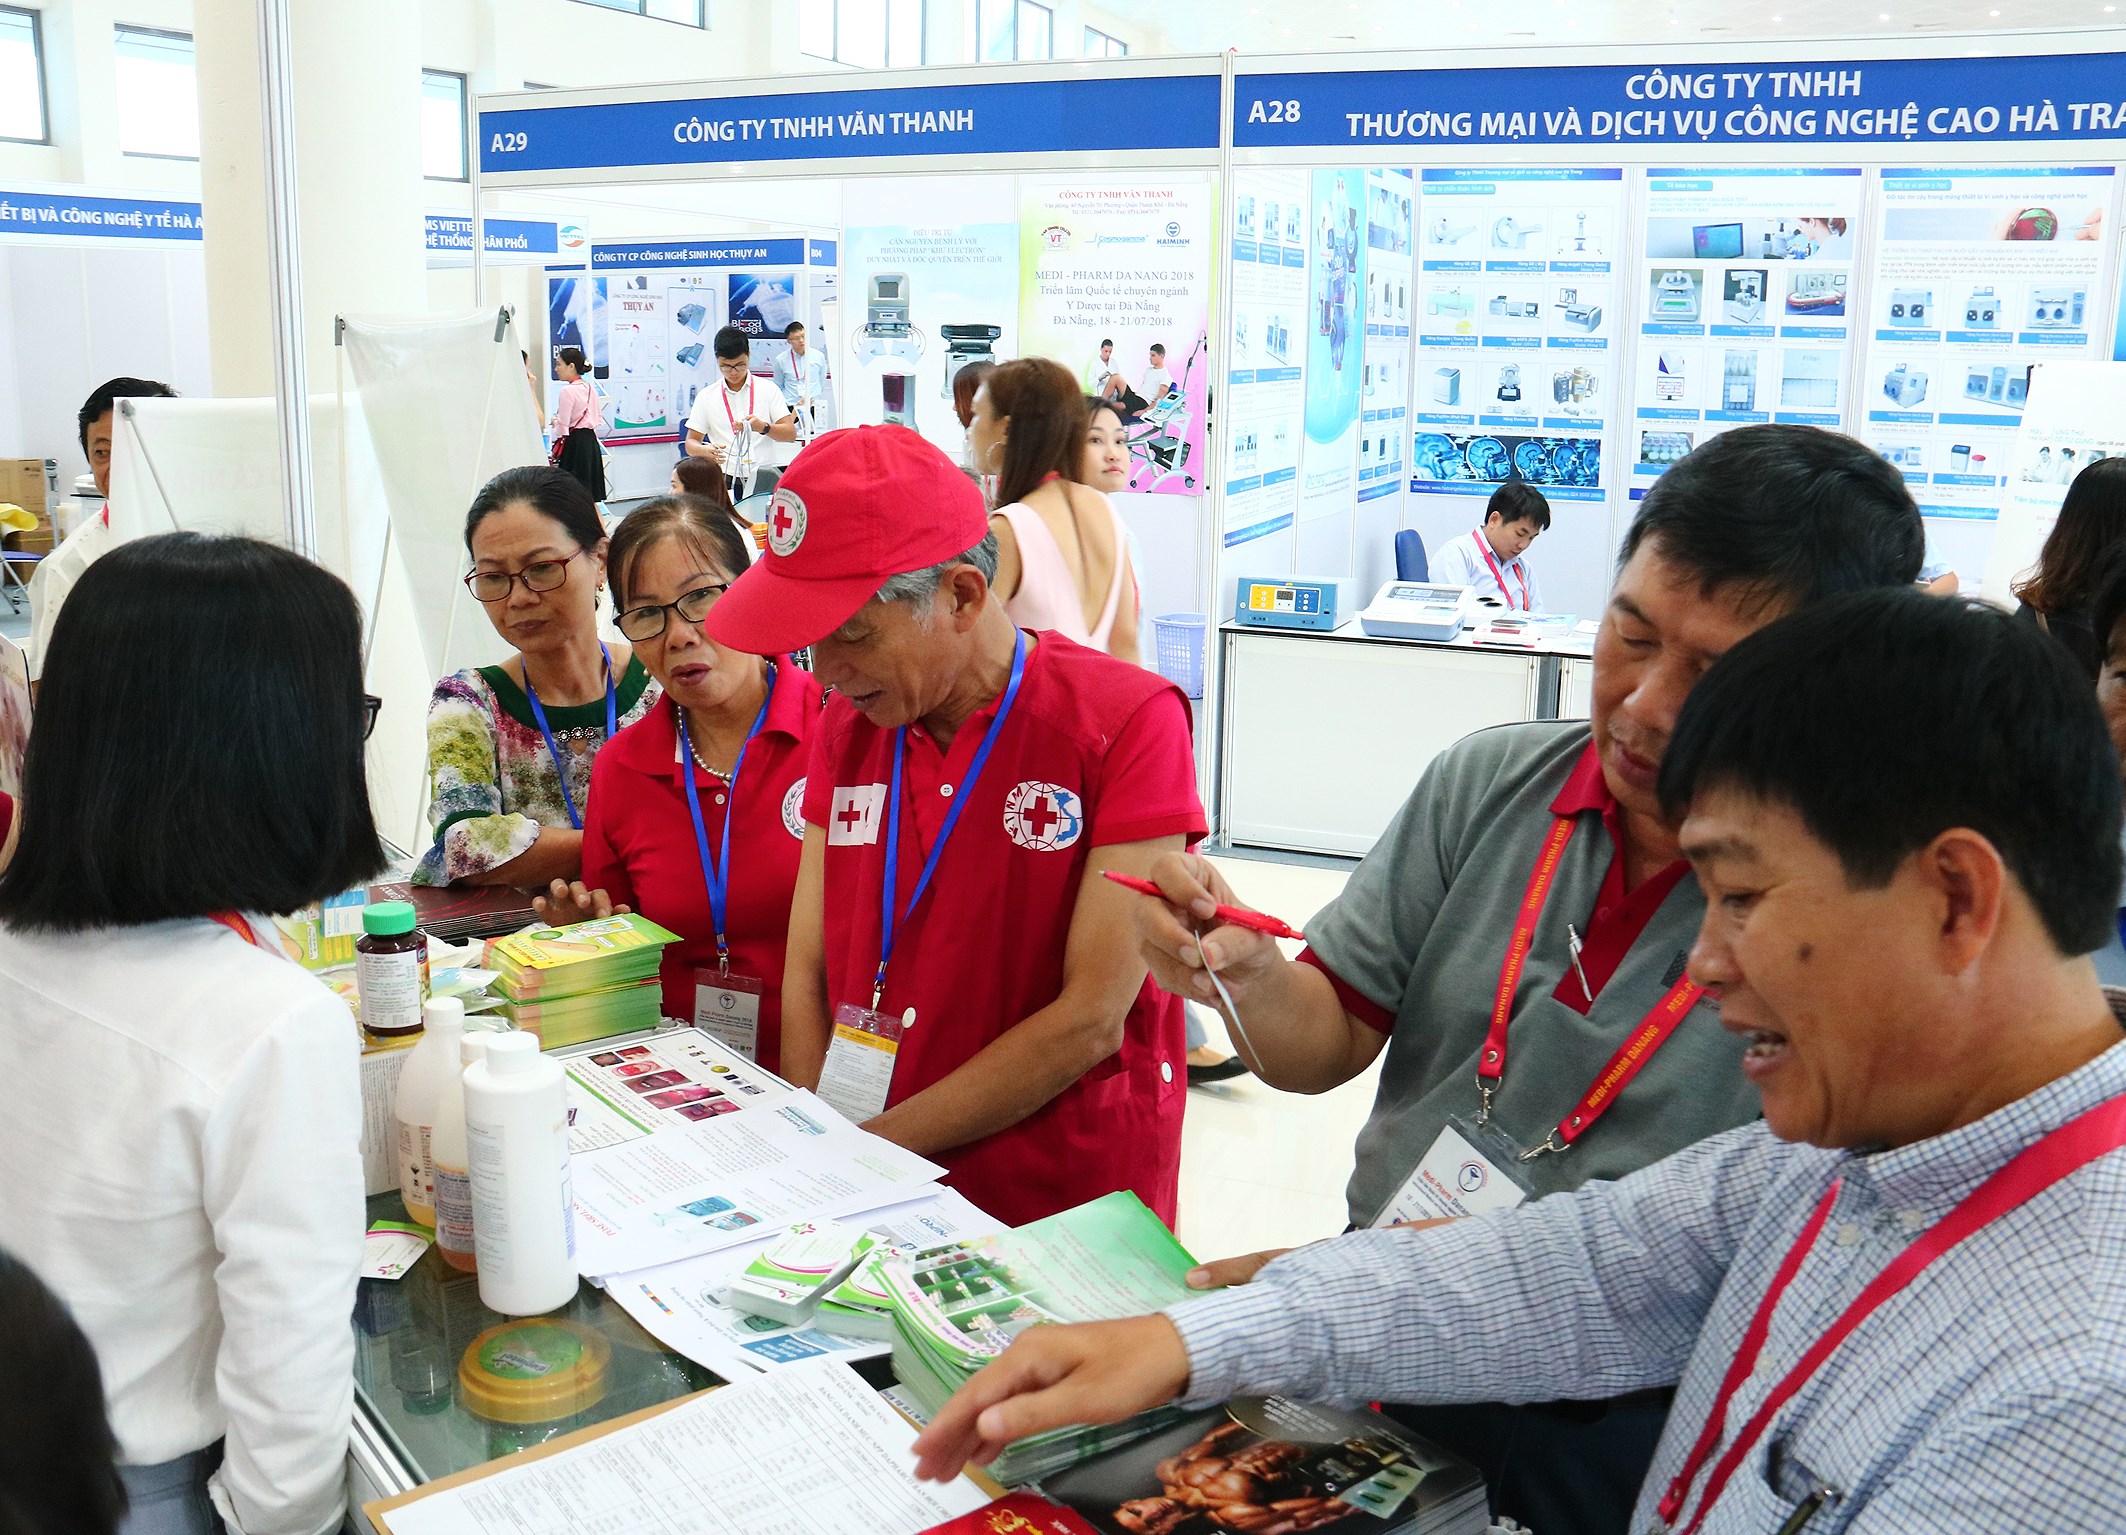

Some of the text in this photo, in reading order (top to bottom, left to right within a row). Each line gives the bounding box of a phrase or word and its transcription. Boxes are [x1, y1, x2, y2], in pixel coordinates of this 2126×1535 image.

[1625, 67, 1862, 101] CÔNG TY TNHH
[1247, 99, 1302, 124] A28
[1345, 109, 1473, 138] THƯƠNG
[1479, 111, 1536, 140] MẠI
[1543, 106, 1584, 136] VÀ
[1591, 110, 1666, 142] DỊCH
[1676, 109, 1720, 142] VỤ
[1724, 103, 1817, 136] CÔNG
[1825, 101, 1920, 140] NGHỆ
[1926, 106, 2001, 134] CAO
[2008, 98, 2061, 133] HÀ
[673, 108, 974, 144] CÔNG TY TNHH VĂN THANH
[491, 131, 528, 153] A29
[1059, 189, 1173, 199] CÔNG TY TNHH VĂN THANH
[0, 201, 19, 221] ẾT
[22, 207, 37, 224] BỊ
[38, 206, 58, 223] VÀ
[61, 207, 102, 225] CÔNG
[104, 210, 144, 229] NGHỆ
[144, 213, 155, 228] Y
[156, 209, 172, 228] TẾ
[174, 214, 193, 229] HÀ
[440, 221, 474, 233] VIETTE
[439, 231, 474, 249] THỐNG
[483, 235, 503, 249] HÂN
[505, 232, 528, 249] PHỐI
[1050, 234, 1062, 243] VT
[593, 248, 767, 263] CÔNG TY CP CÔNG NGHỆ SINH HỌC THỤY AN
[1034, 271, 1194, 281] MEDI PHARM DA NANG 2018
[1040, 283, 1189, 298] Triển lãm Quốc tế chuyên ngành
[1066, 299, 1161, 313] Y Dược tại Đà Nẵng
[1495, 927, 1528, 1024] MEDI-PHARM DANANG
[1666, 981, 1695, 1013] MEDI-P
[1586, 1024, 1660, 1108] MEDI-PHARM DANANG
